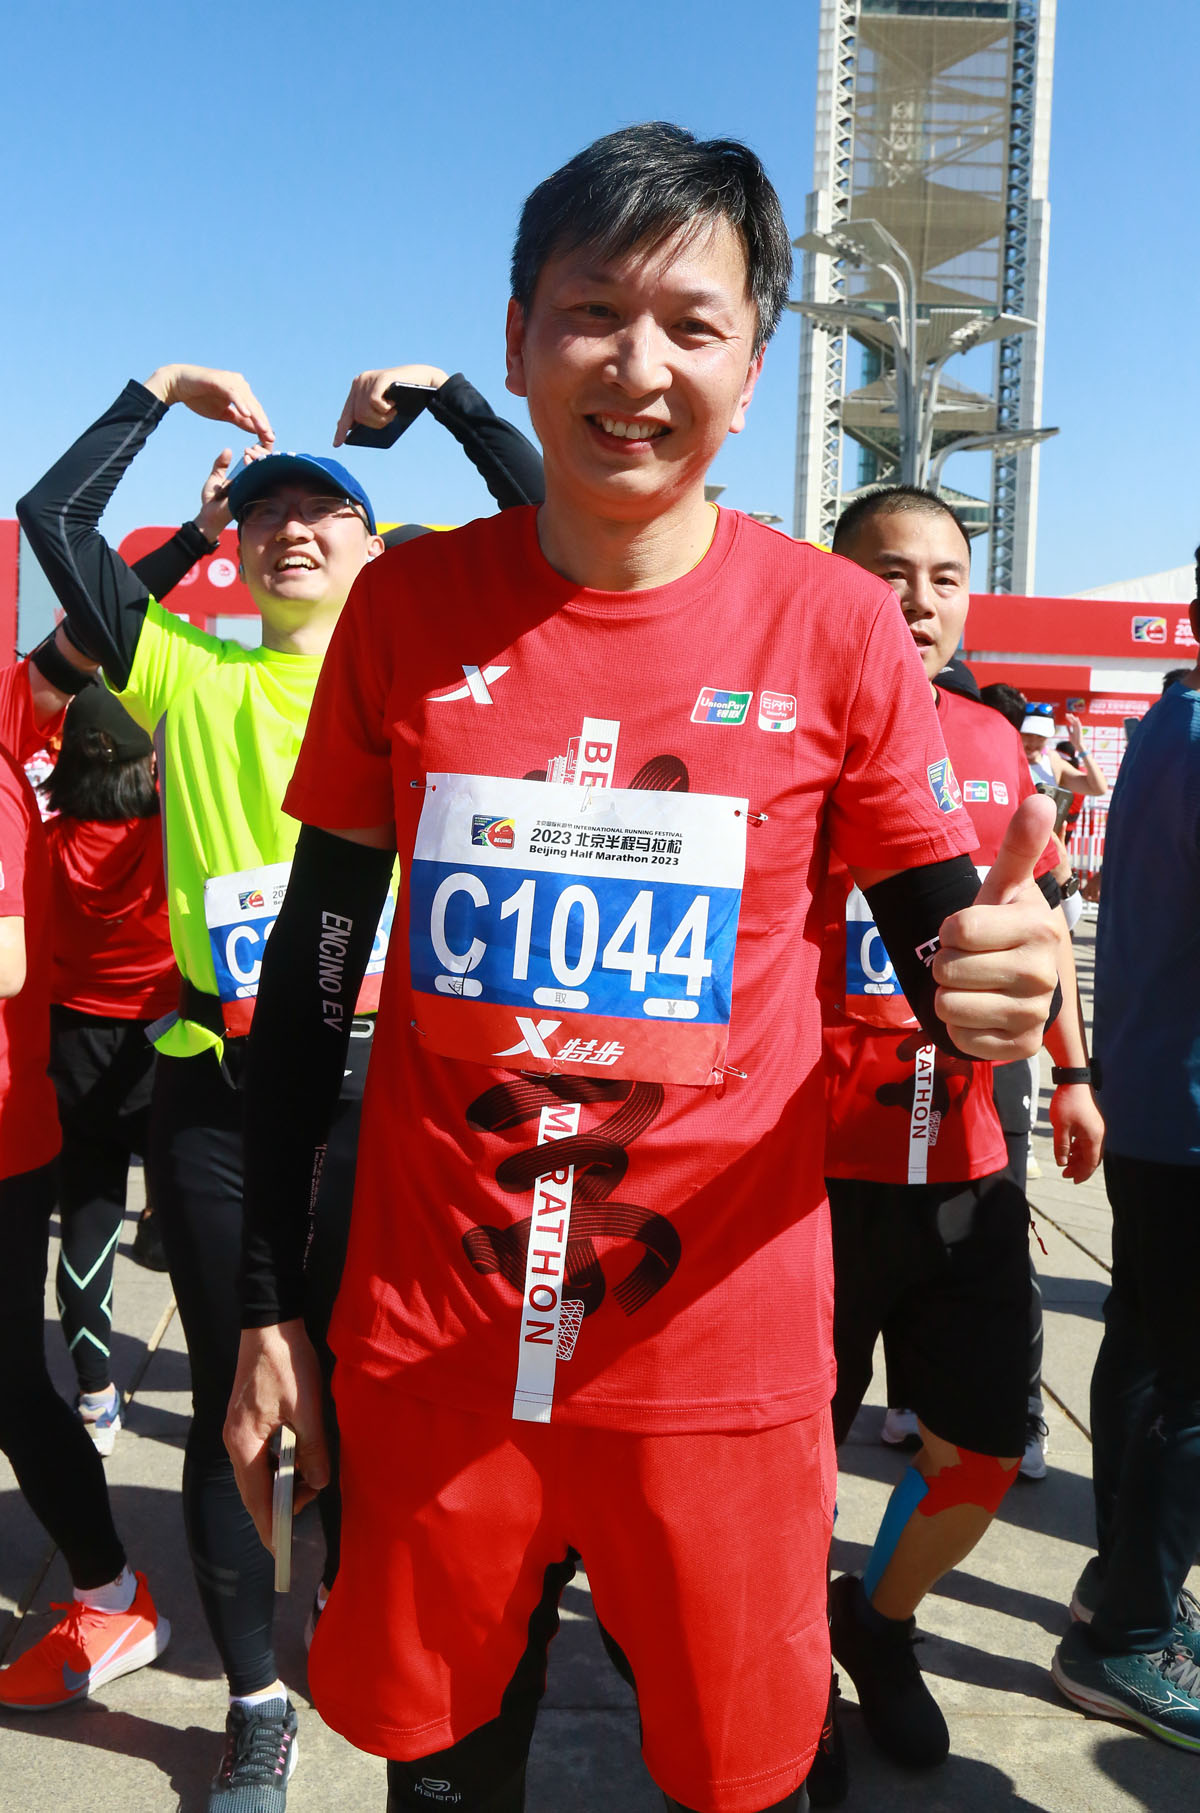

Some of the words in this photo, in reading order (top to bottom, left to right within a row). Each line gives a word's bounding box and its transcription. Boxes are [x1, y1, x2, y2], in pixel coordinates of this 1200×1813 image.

[700, 697, 745, 711] UnionPay
[763, 698, 793, 711] 云闪付
[530, 828, 572, 845] 2023
[574, 832, 683, 854] 北京半程马拉松
[573, 825, 623, 834] INTERNATIONAL
[529, 845, 567, 859] Beijing
[570, 850, 593, 860] Half
[595, 852, 648, 864] Marathon
[651, 856, 679, 866] 2023
[272, 889, 286, 900] 20
[430, 872, 712, 997] C1044
[226, 920, 276, 984] C
[319, 911, 353, 993] ENCINO
[554, 992, 567, 1004] 取
[322, 1000, 343, 1032] EV
[556, 1038, 625, 1066] 特步
[525, 1104, 577, 1346] MRATHON
[414, 1783, 461, 1803] Kalenji
